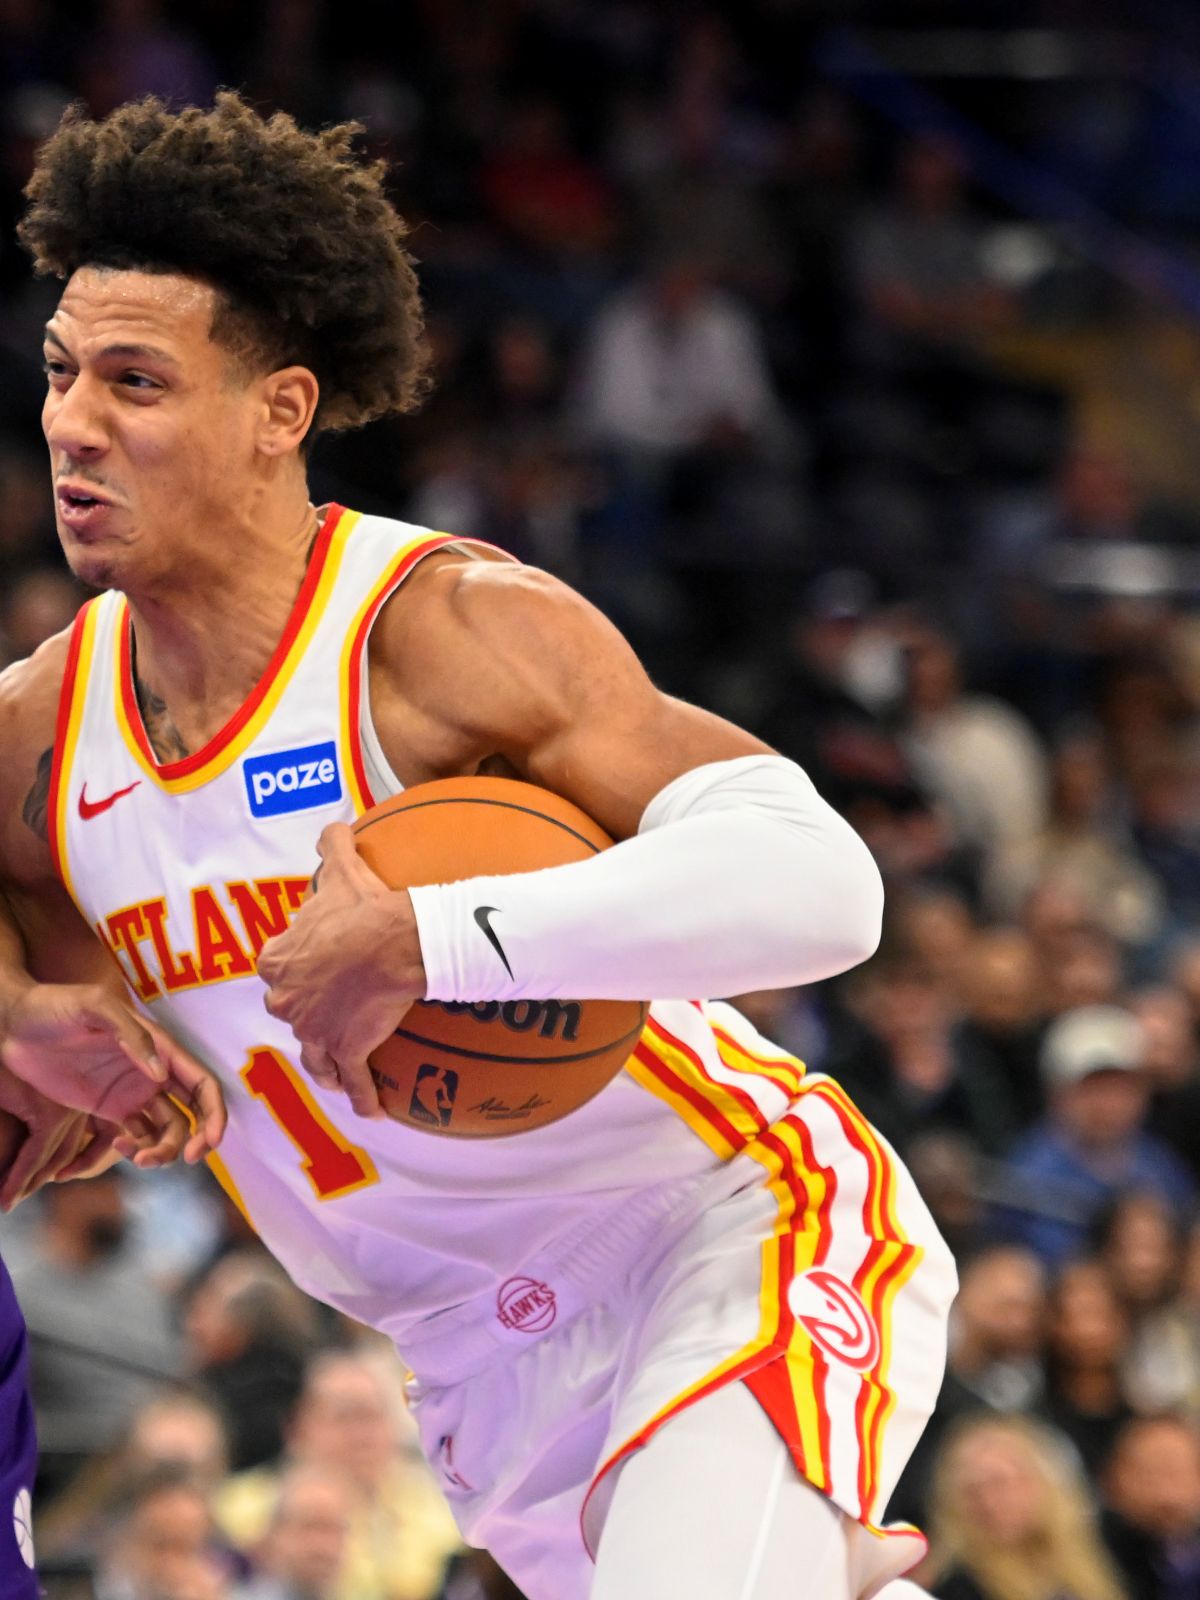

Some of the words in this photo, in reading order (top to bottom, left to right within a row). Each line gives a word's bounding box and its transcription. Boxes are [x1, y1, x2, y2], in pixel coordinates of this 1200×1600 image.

[252, 758, 335, 805] paze
[96, 876, 312, 1003] TLAN
[239, 1044, 382, 1202] 1
[496, 1281, 556, 1330] HAWKS
